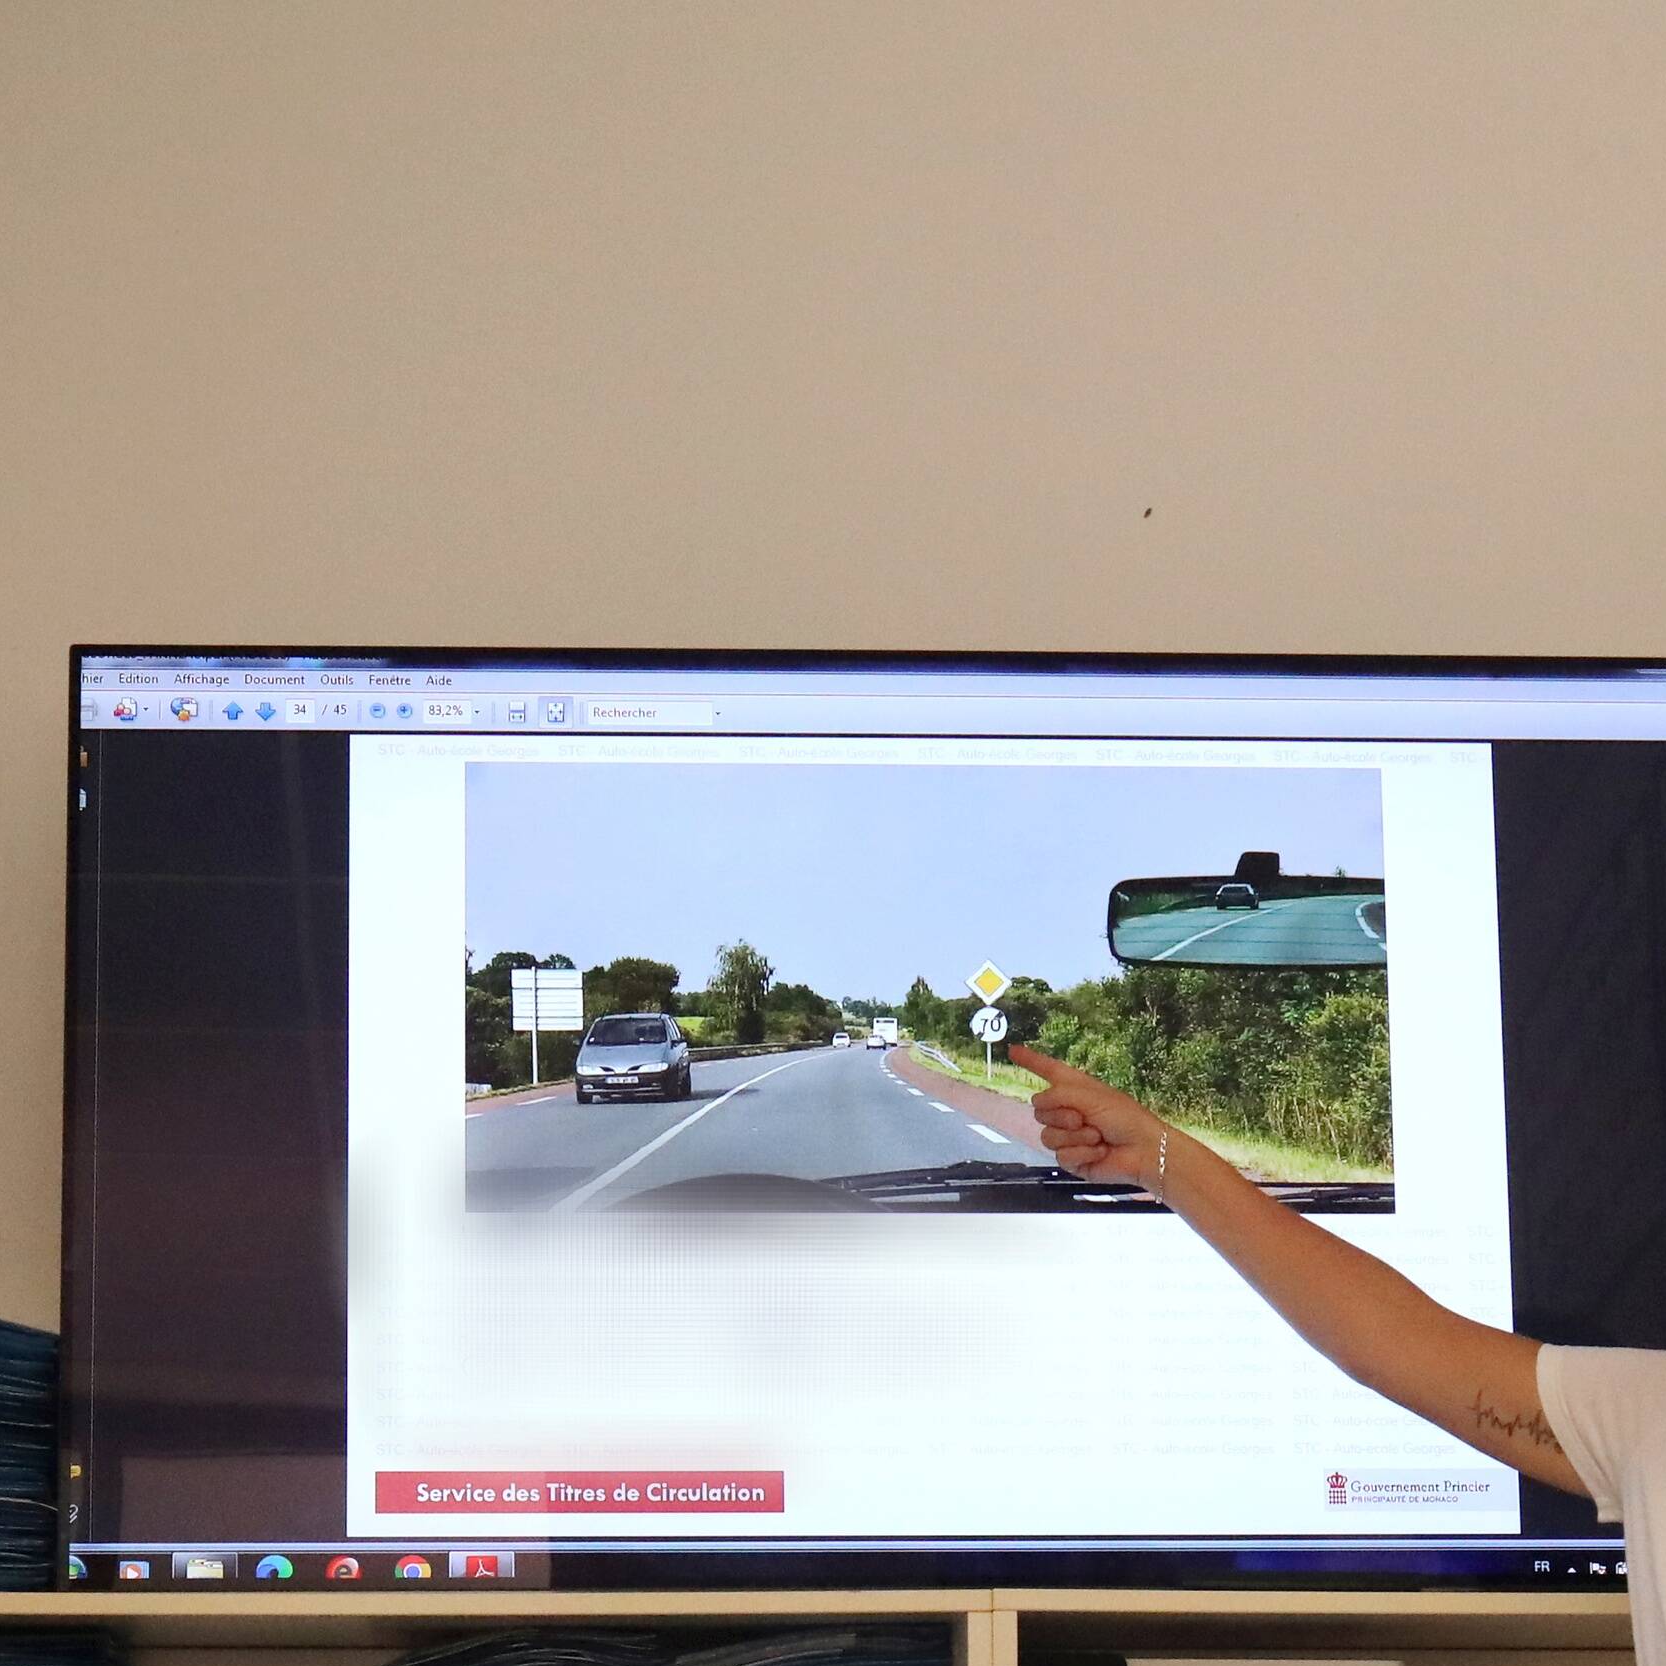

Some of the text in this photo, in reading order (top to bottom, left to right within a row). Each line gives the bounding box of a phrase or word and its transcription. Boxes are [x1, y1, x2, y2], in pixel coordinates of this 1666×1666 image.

[119, 673, 159, 684] Edition
[174, 673, 230, 687] Affichage
[245, 674, 305, 685] Document
[320, 674, 353, 685] Outils
[426, 675, 453, 686] Aide
[293, 704, 306, 715] 34
[333, 704, 347, 715] 45
[428, 705, 463, 717] 83,2%
[592, 706, 658, 720] Rechercher
[980, 1018, 1001, 1034] 70
[416, 1482, 766, 1503] Service des Titres de Circulation
[1350, 1480, 1491, 1493] Gouvernement Princier
[1408, 1496, 1420, 1504] DE
[1422, 1496, 1459, 1504] MONACO
[1534, 1560, 1550, 1572] FR
